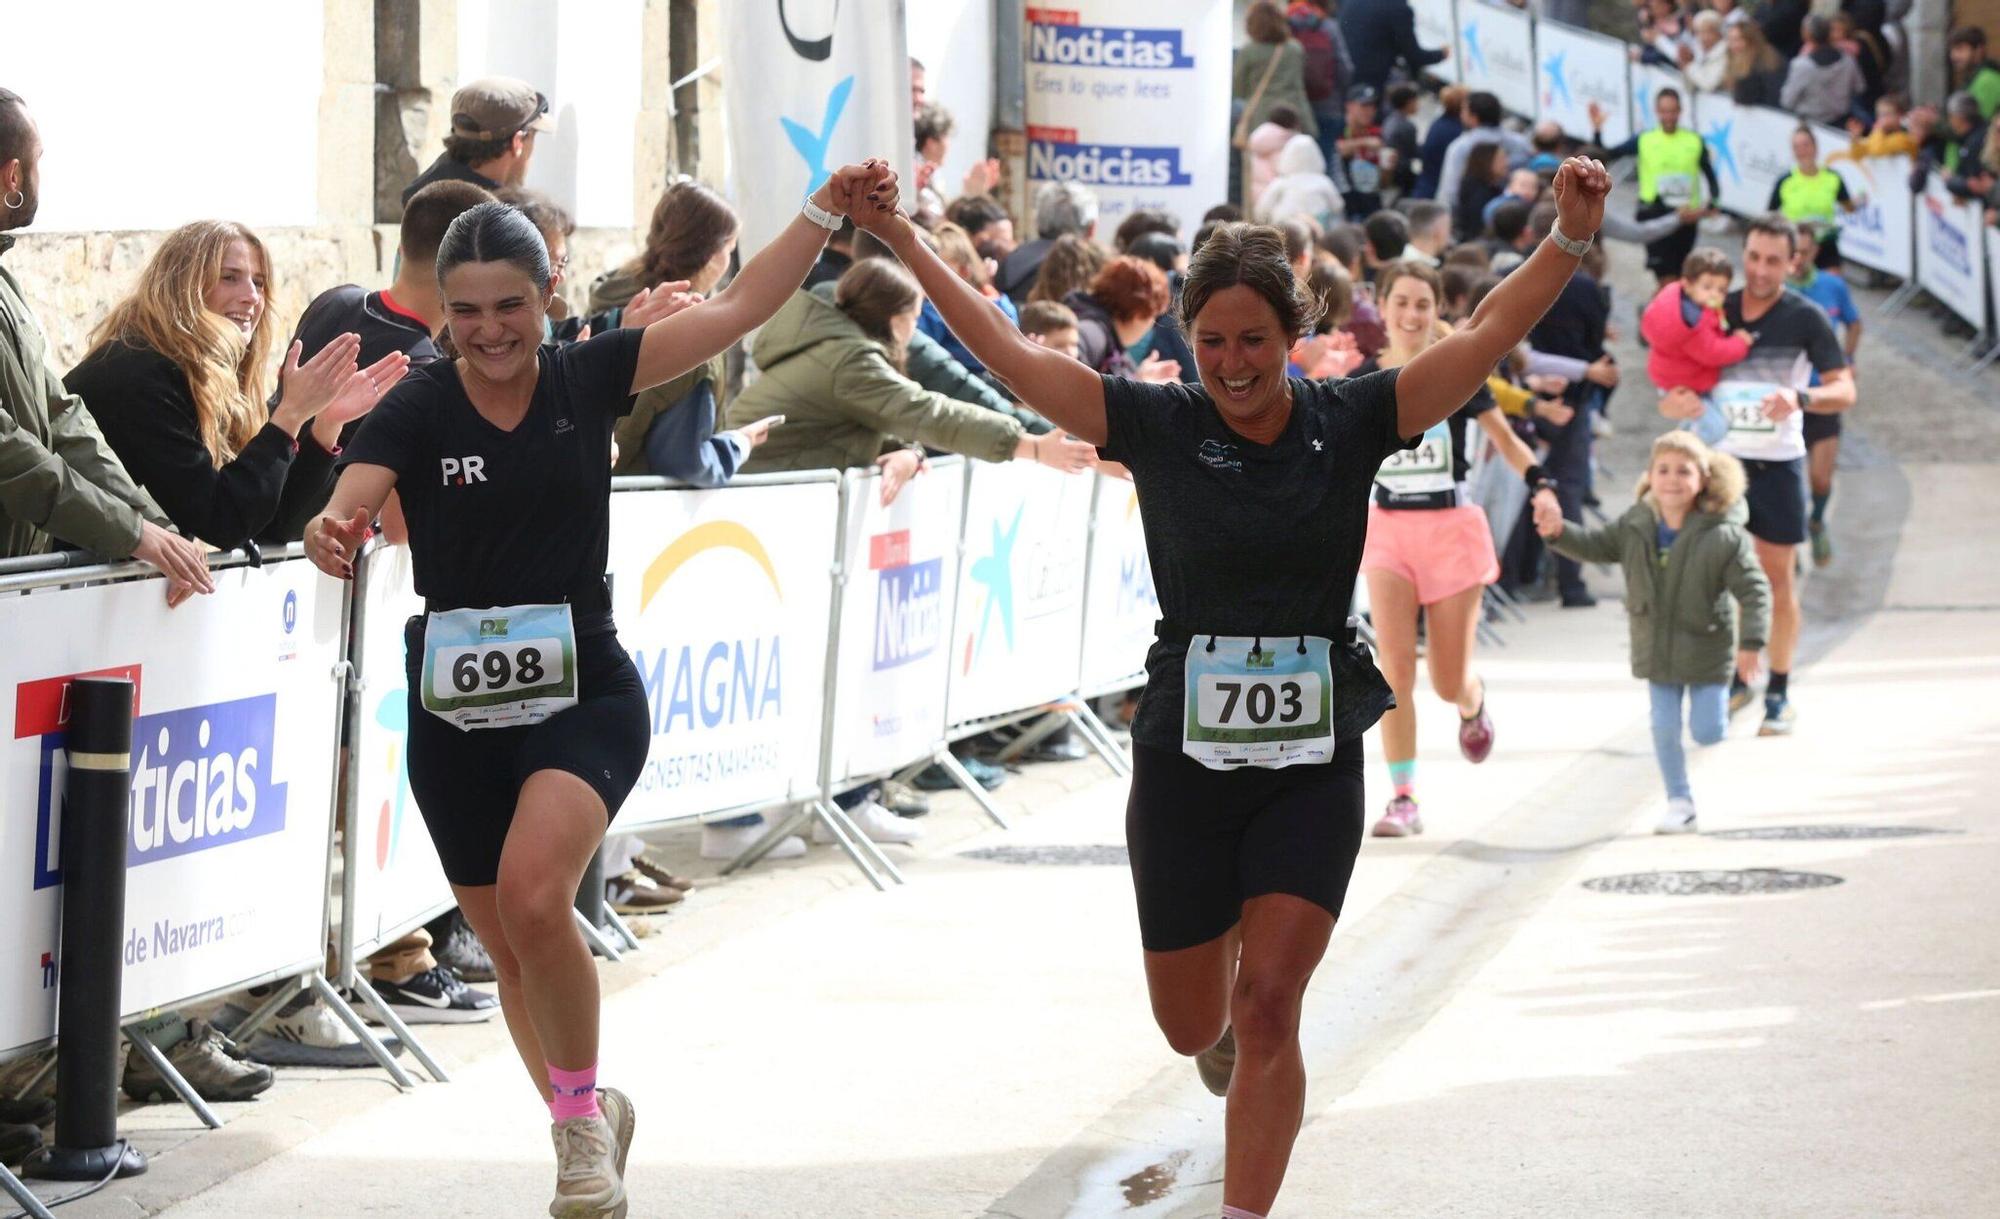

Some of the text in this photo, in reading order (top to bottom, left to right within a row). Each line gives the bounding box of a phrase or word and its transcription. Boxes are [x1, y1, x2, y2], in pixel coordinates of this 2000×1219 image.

[1032, 26, 1173, 67] Noticias
[1033, 74, 1170, 98] Eres lo que lees
[1029, 143, 1172, 185] Noticias
[452, 647, 545, 693] 698
[635, 634, 782, 736] MAGNA
[1215, 681, 1303, 724] 703
[634, 751, 712, 792] AGNESITAS
[125, 928, 147, 966] de
[153, 915, 225, 957] Navarra
